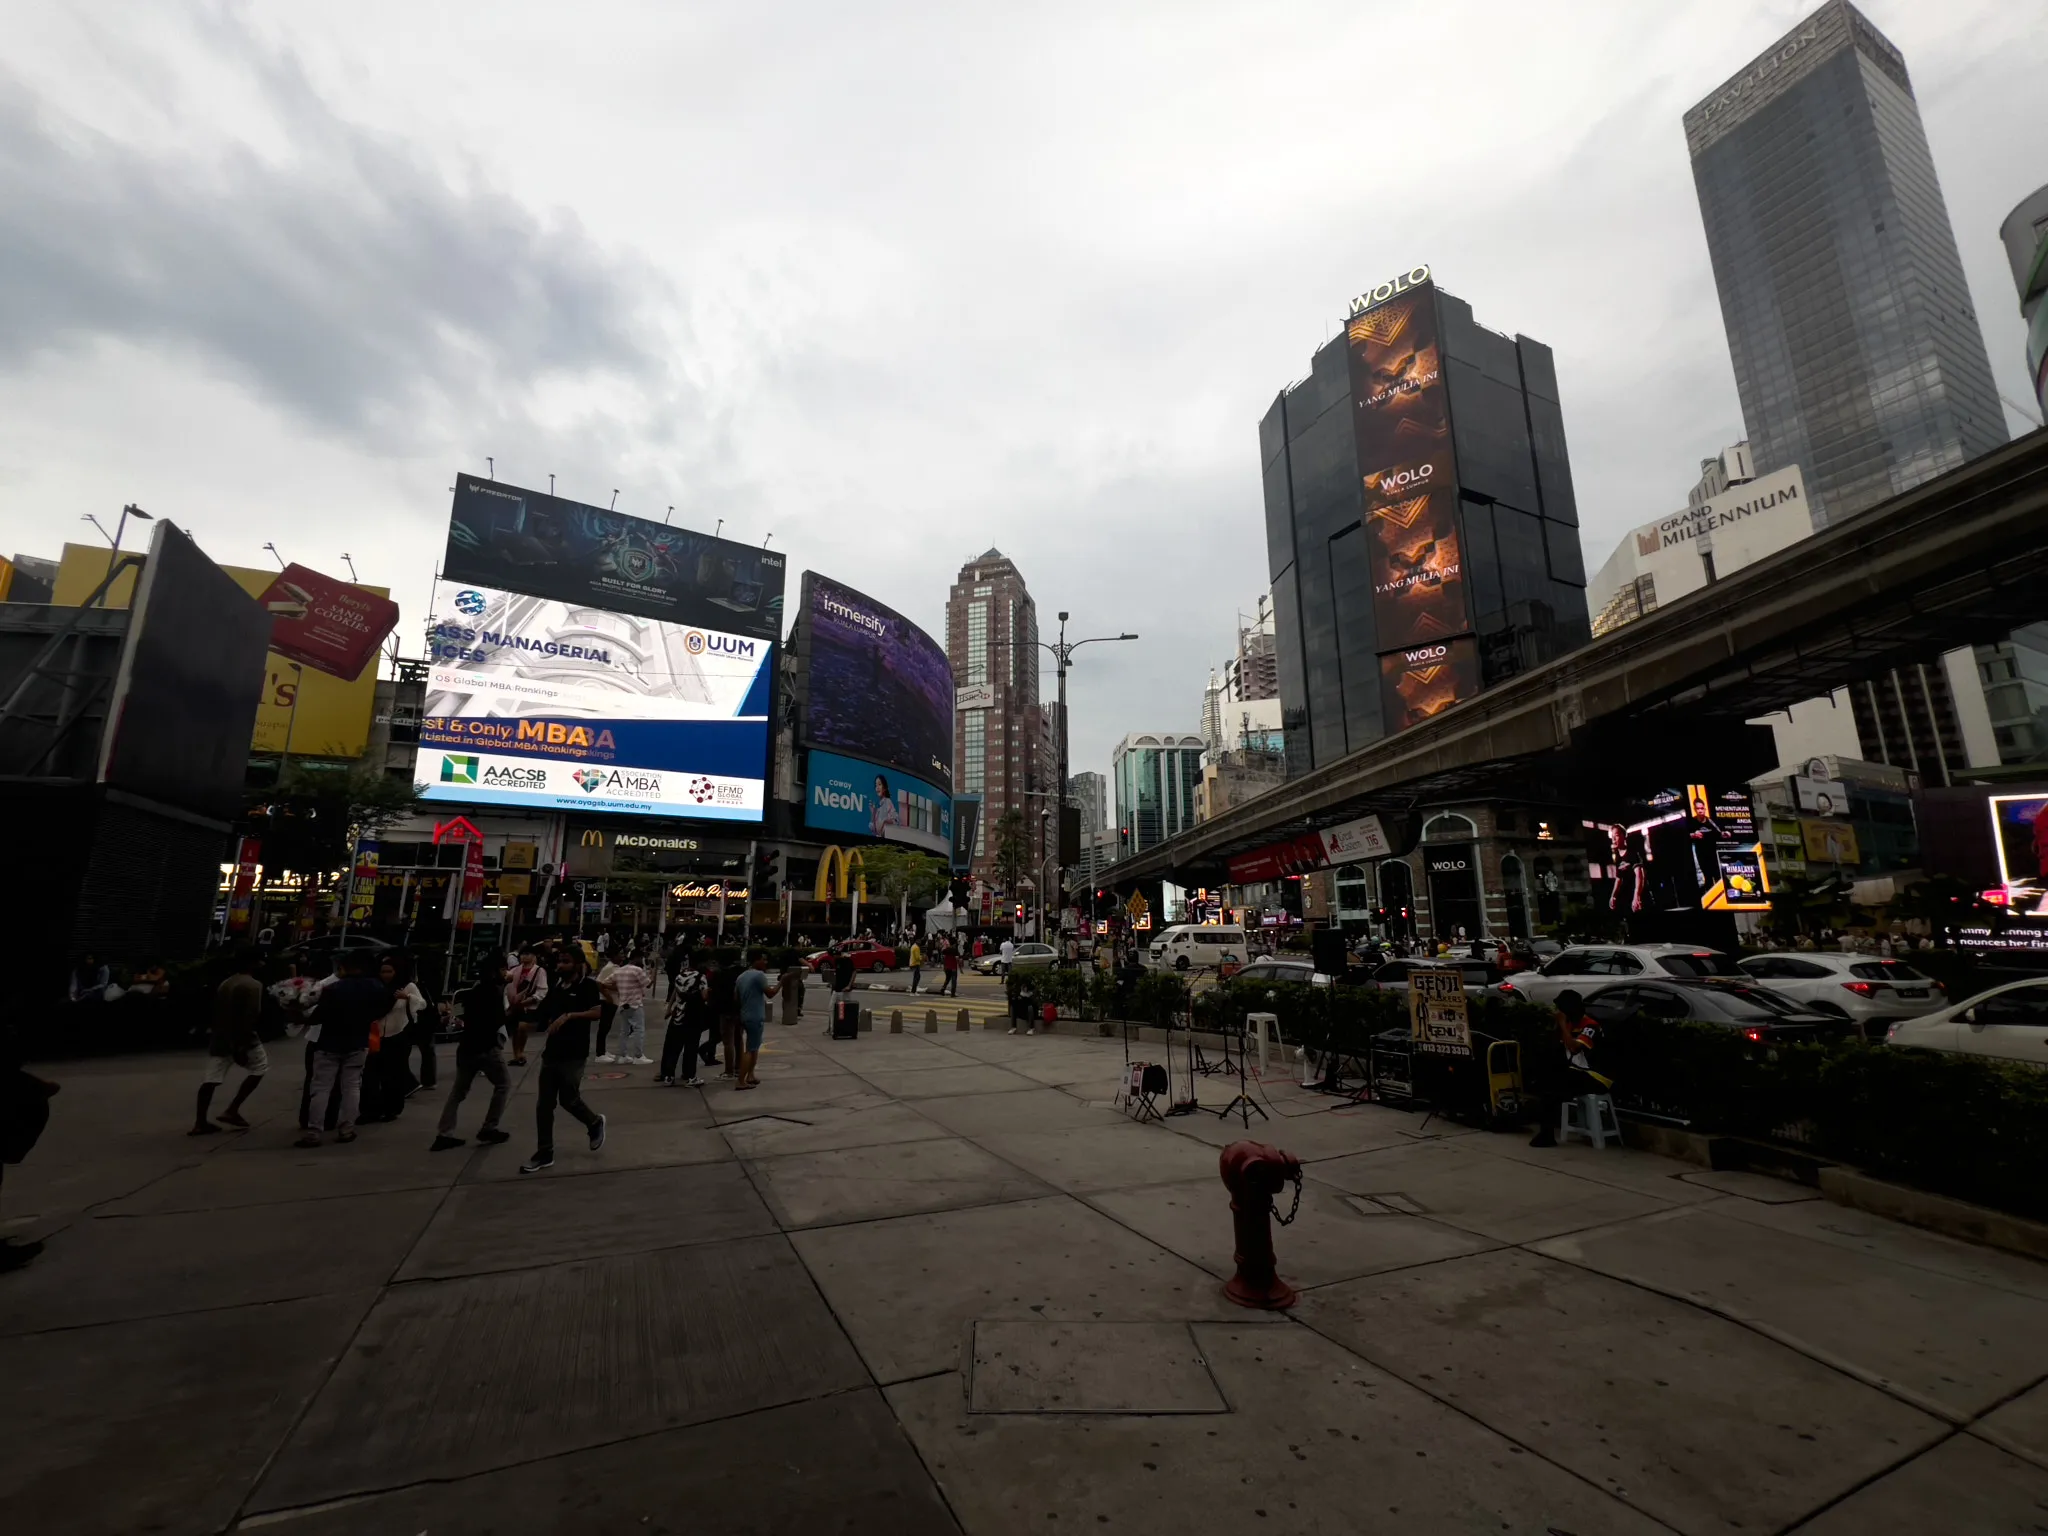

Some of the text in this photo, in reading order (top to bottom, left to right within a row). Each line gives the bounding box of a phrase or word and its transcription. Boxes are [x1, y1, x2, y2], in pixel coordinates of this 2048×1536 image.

[1703, 18, 1823, 120] PAVILION
[1348, 264, 1429, 313] WOLO
[1358, 370, 1438, 408] YANG MULIA INI
[1380, 464, 1433, 490] WOLO
[480, 487, 523, 501] PREDATOR
[1660, 505, 1713, 531] GRAND
[1663, 484, 1798, 548] MILLENNIUM
[761, 555, 782, 568] intel
[602, 576, 667, 595] BUILT FOR GLORY
[1375, 564, 1459, 594] YANG MULIA INI
[314, 607, 371, 633] COOKIES
[331, 604, 364, 622] SAND
[824, 595, 886, 637] immersify
[482, 631, 612, 663] MANAGERIAL
[707, 634, 755, 657] UUM
[1405, 645, 1447, 662] WOLO
[453, 676, 487, 688] Global
[490, 681, 512, 691] MBA
[514, 685, 559, 698] Rankings
[425, 732, 461, 744] Listed
[462, 735, 474, 744] in
[476, 737, 512, 748] Global
[514, 742, 538, 751] MBA
[468, 721, 512, 739] Only
[518, 719, 589, 747] MBA
[484, 765, 547, 782] AACSB
[482, 778, 546, 790] ACCREDITED
[717, 785, 744, 795] EFMD
[828, 778, 852, 789] coway
[606, 788, 662, 799] ACCREDITED
[615, 834, 698, 849] McDonald's
[1432, 860, 1467, 871] WOLO
[671, 881, 706, 898] Kadir
[2009, 939, 2028, 947] her
[1414, 975, 1460, 994] GENJI
